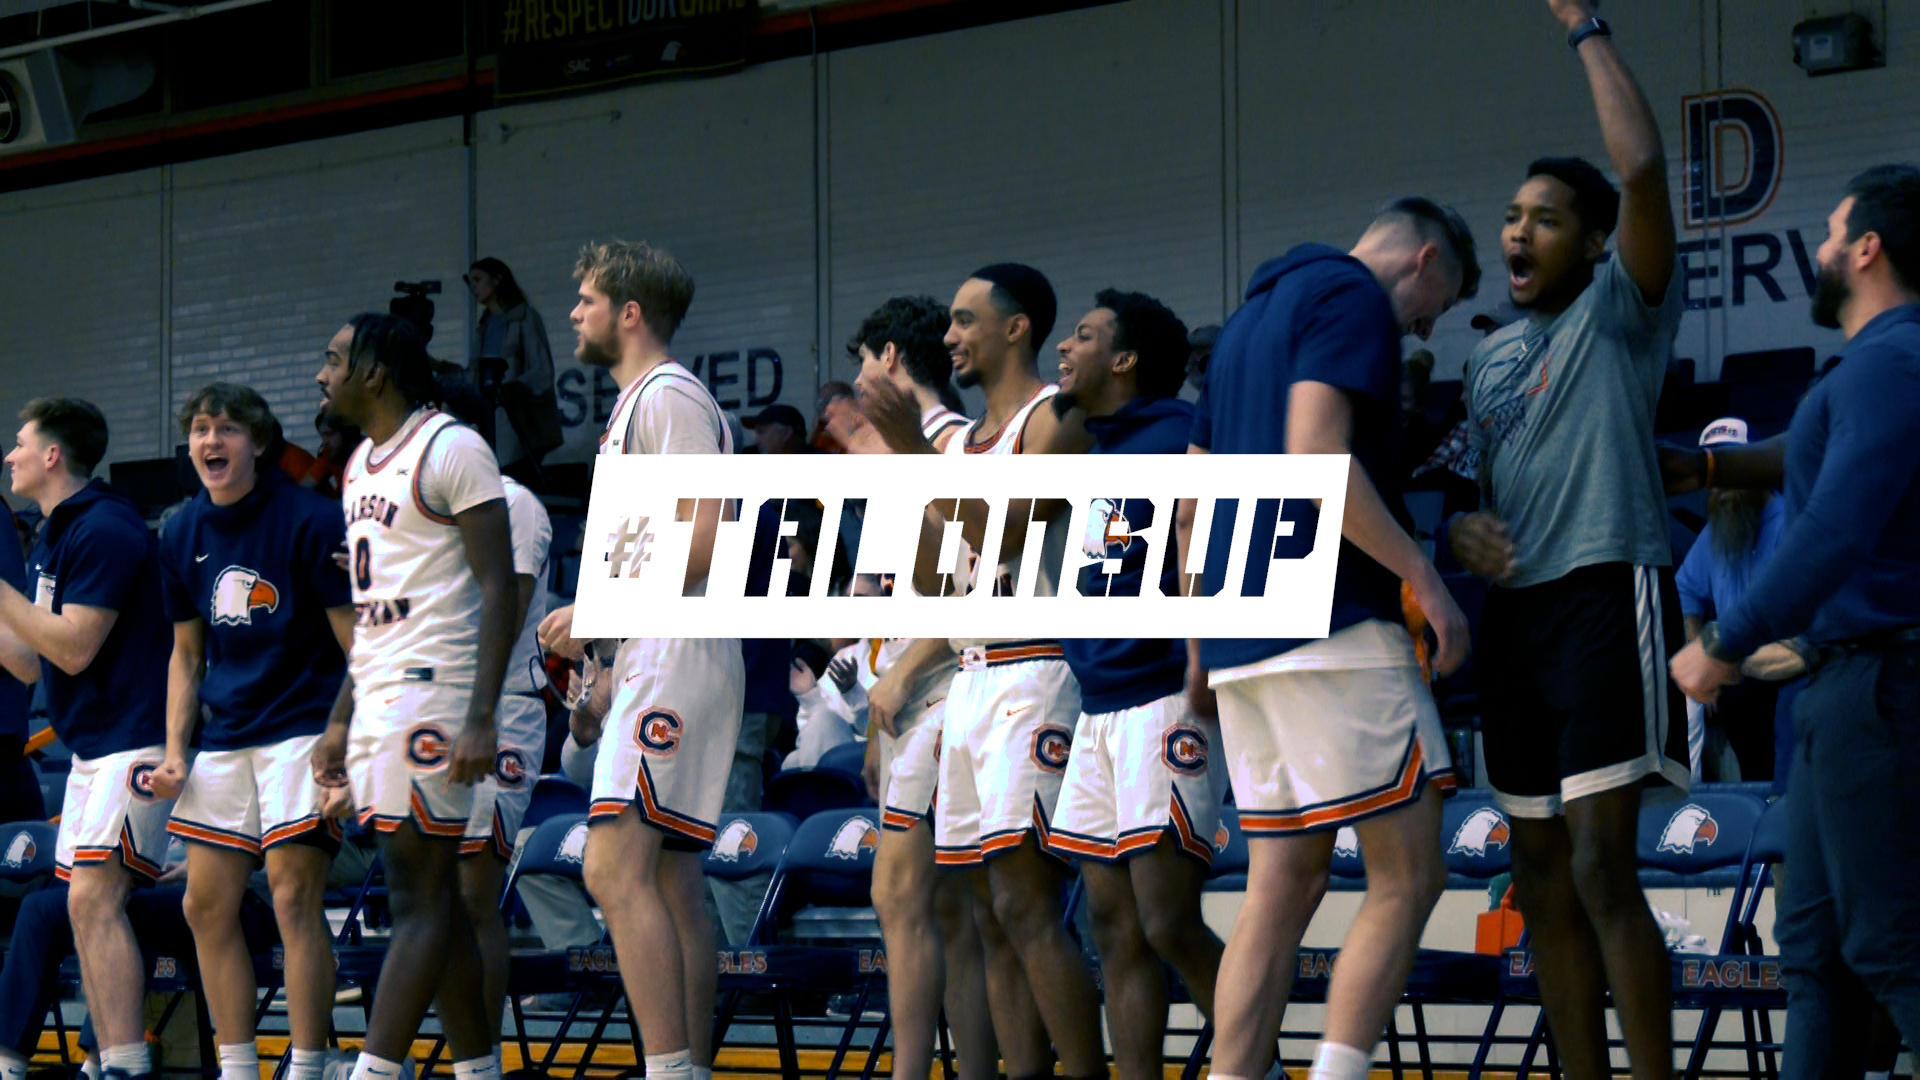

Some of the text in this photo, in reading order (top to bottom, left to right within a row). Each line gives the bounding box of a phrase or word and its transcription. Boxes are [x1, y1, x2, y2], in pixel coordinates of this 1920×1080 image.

[1681, 89, 1784, 230] D
[356, 536, 373, 591] 0
[569, 949, 620, 972] EAGL
